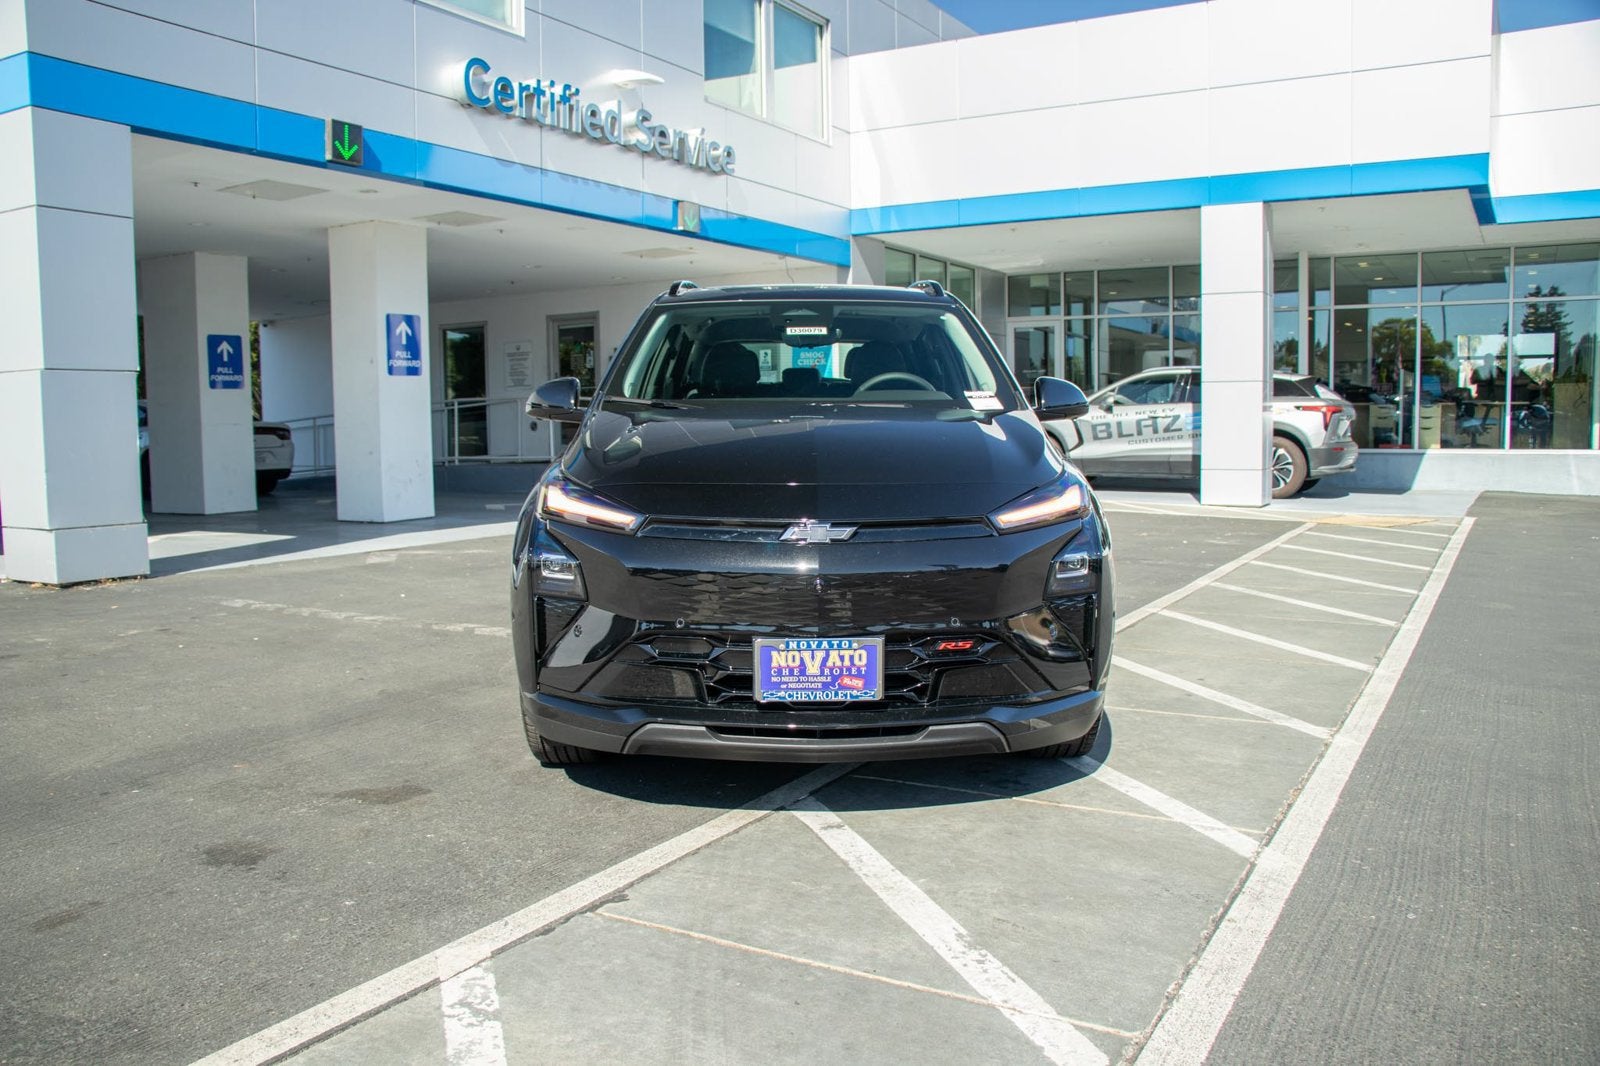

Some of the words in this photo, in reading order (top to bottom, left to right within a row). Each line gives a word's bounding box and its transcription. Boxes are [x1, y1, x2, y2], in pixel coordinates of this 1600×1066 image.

[464, 57, 623, 145] Certified
[634, 108, 737, 175] Service
[395, 351, 411, 359] PULL
[800, 351, 825, 359] SMOG
[1128, 435, 1184, 445] CUSTOMER
[788, 640, 850, 649] NOVATO
[936, 641, 974, 651] RS
[771, 649, 868, 675] NOVATO
[785, 691, 853, 700] CHEVROLET
